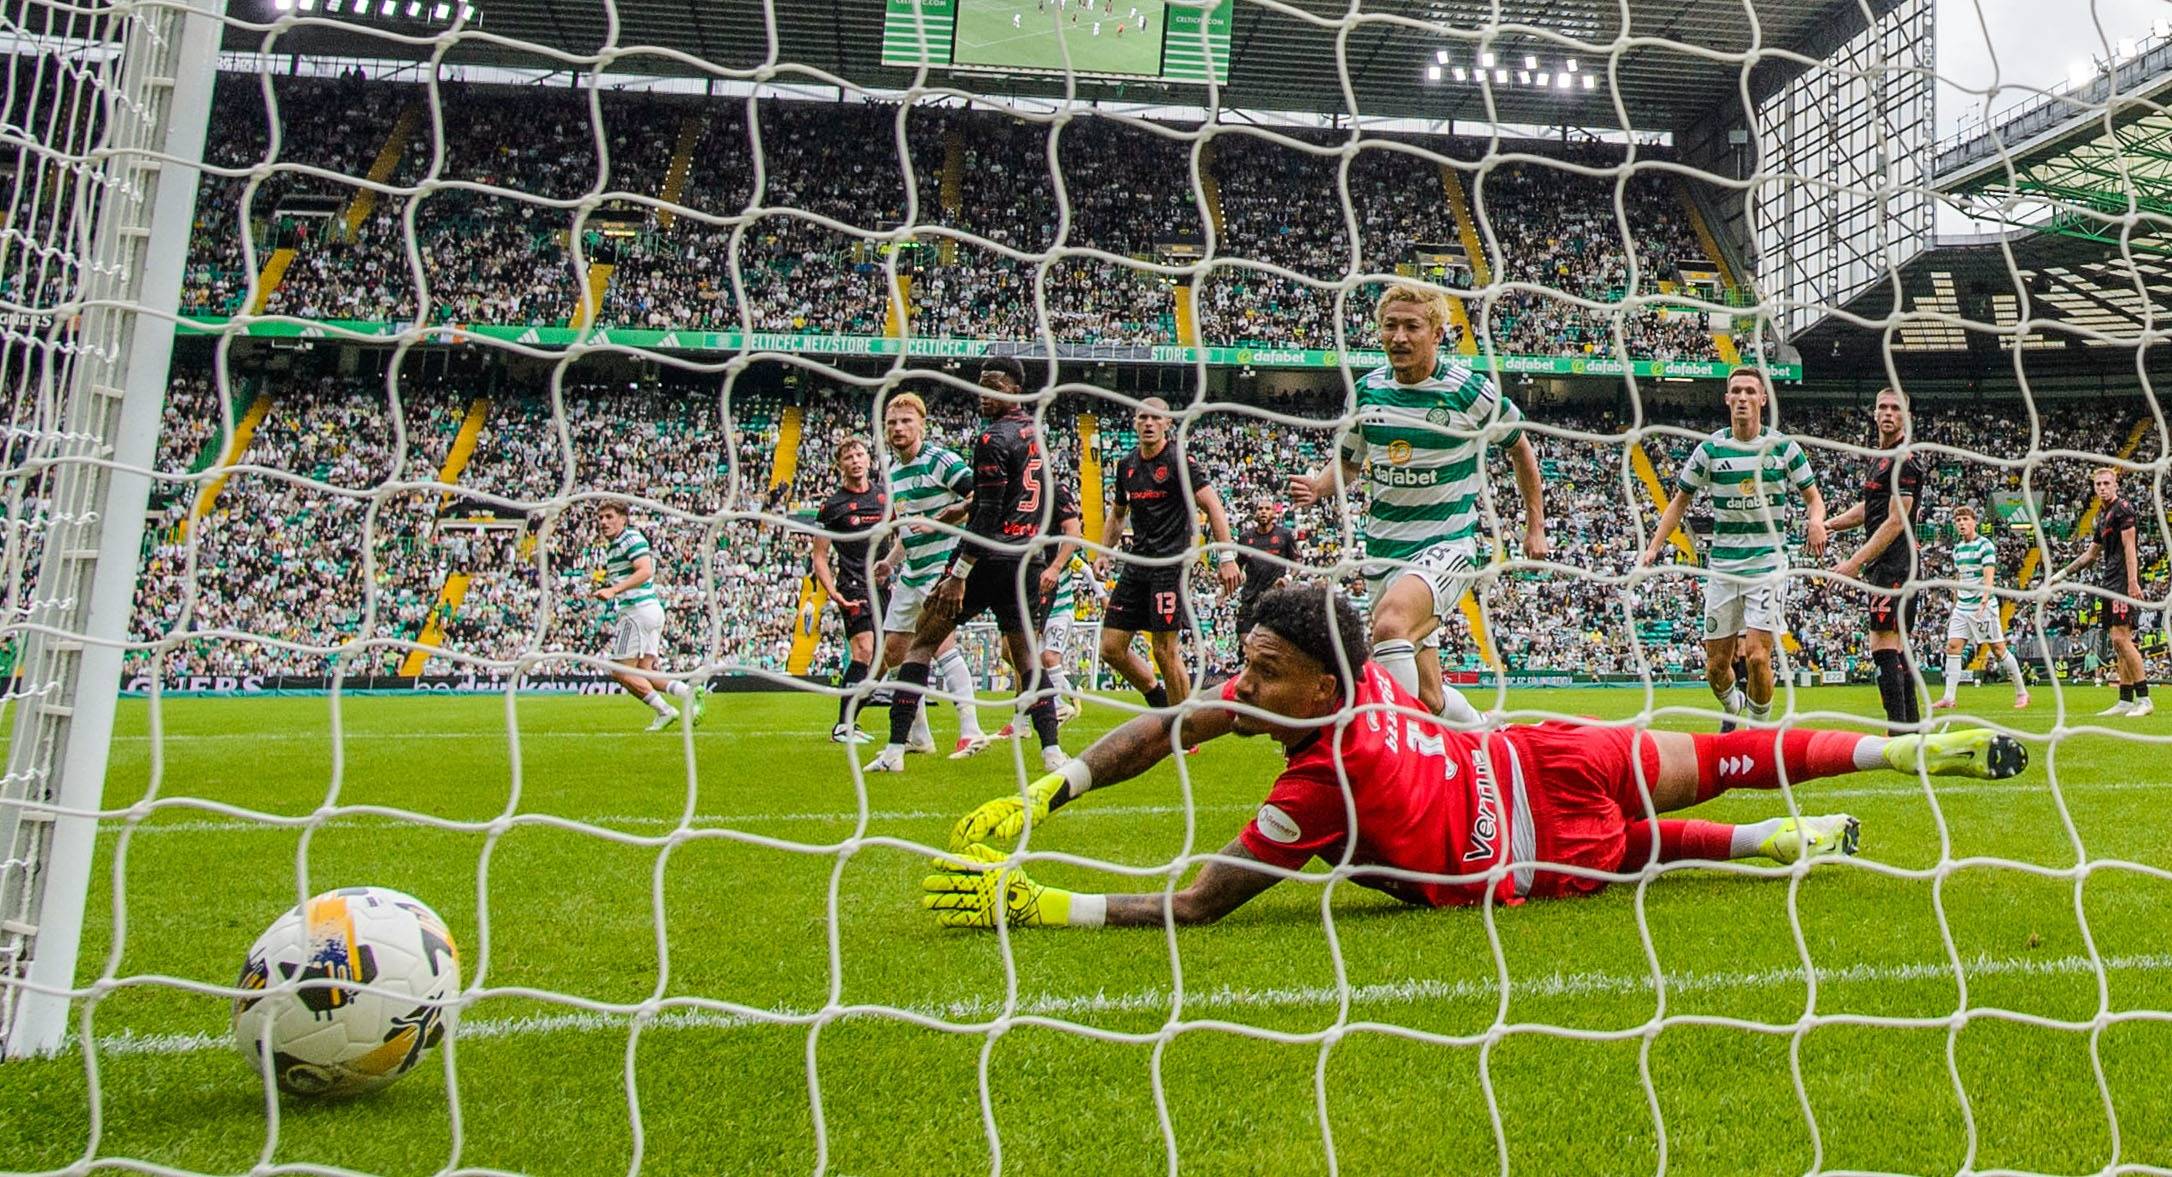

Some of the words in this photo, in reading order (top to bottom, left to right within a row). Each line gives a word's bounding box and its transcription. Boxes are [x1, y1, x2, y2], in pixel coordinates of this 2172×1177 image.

[751, 334, 871, 352] ELTICFC.NET/STORE
[1151, 346, 1188, 361] STORE
[1253, 351, 1304, 363] dafabet
[1505, 359, 1554, 371] dafabet
[1586, 361, 1635, 373] dafabt
[1665, 363, 1713, 376] dafabet
[1374, 465, 1437, 486] dafabet
[1017, 459, 1042, 512] 5
[1726, 496, 1774, 510] dafabt
[1155, 592, 1177, 614] 13
[1761, 589, 1783, 612] 24
[1976, 621, 1990, 633] 27
[1825, 671, 1843, 682] E22
[1406, 719, 1446, 756] 1
